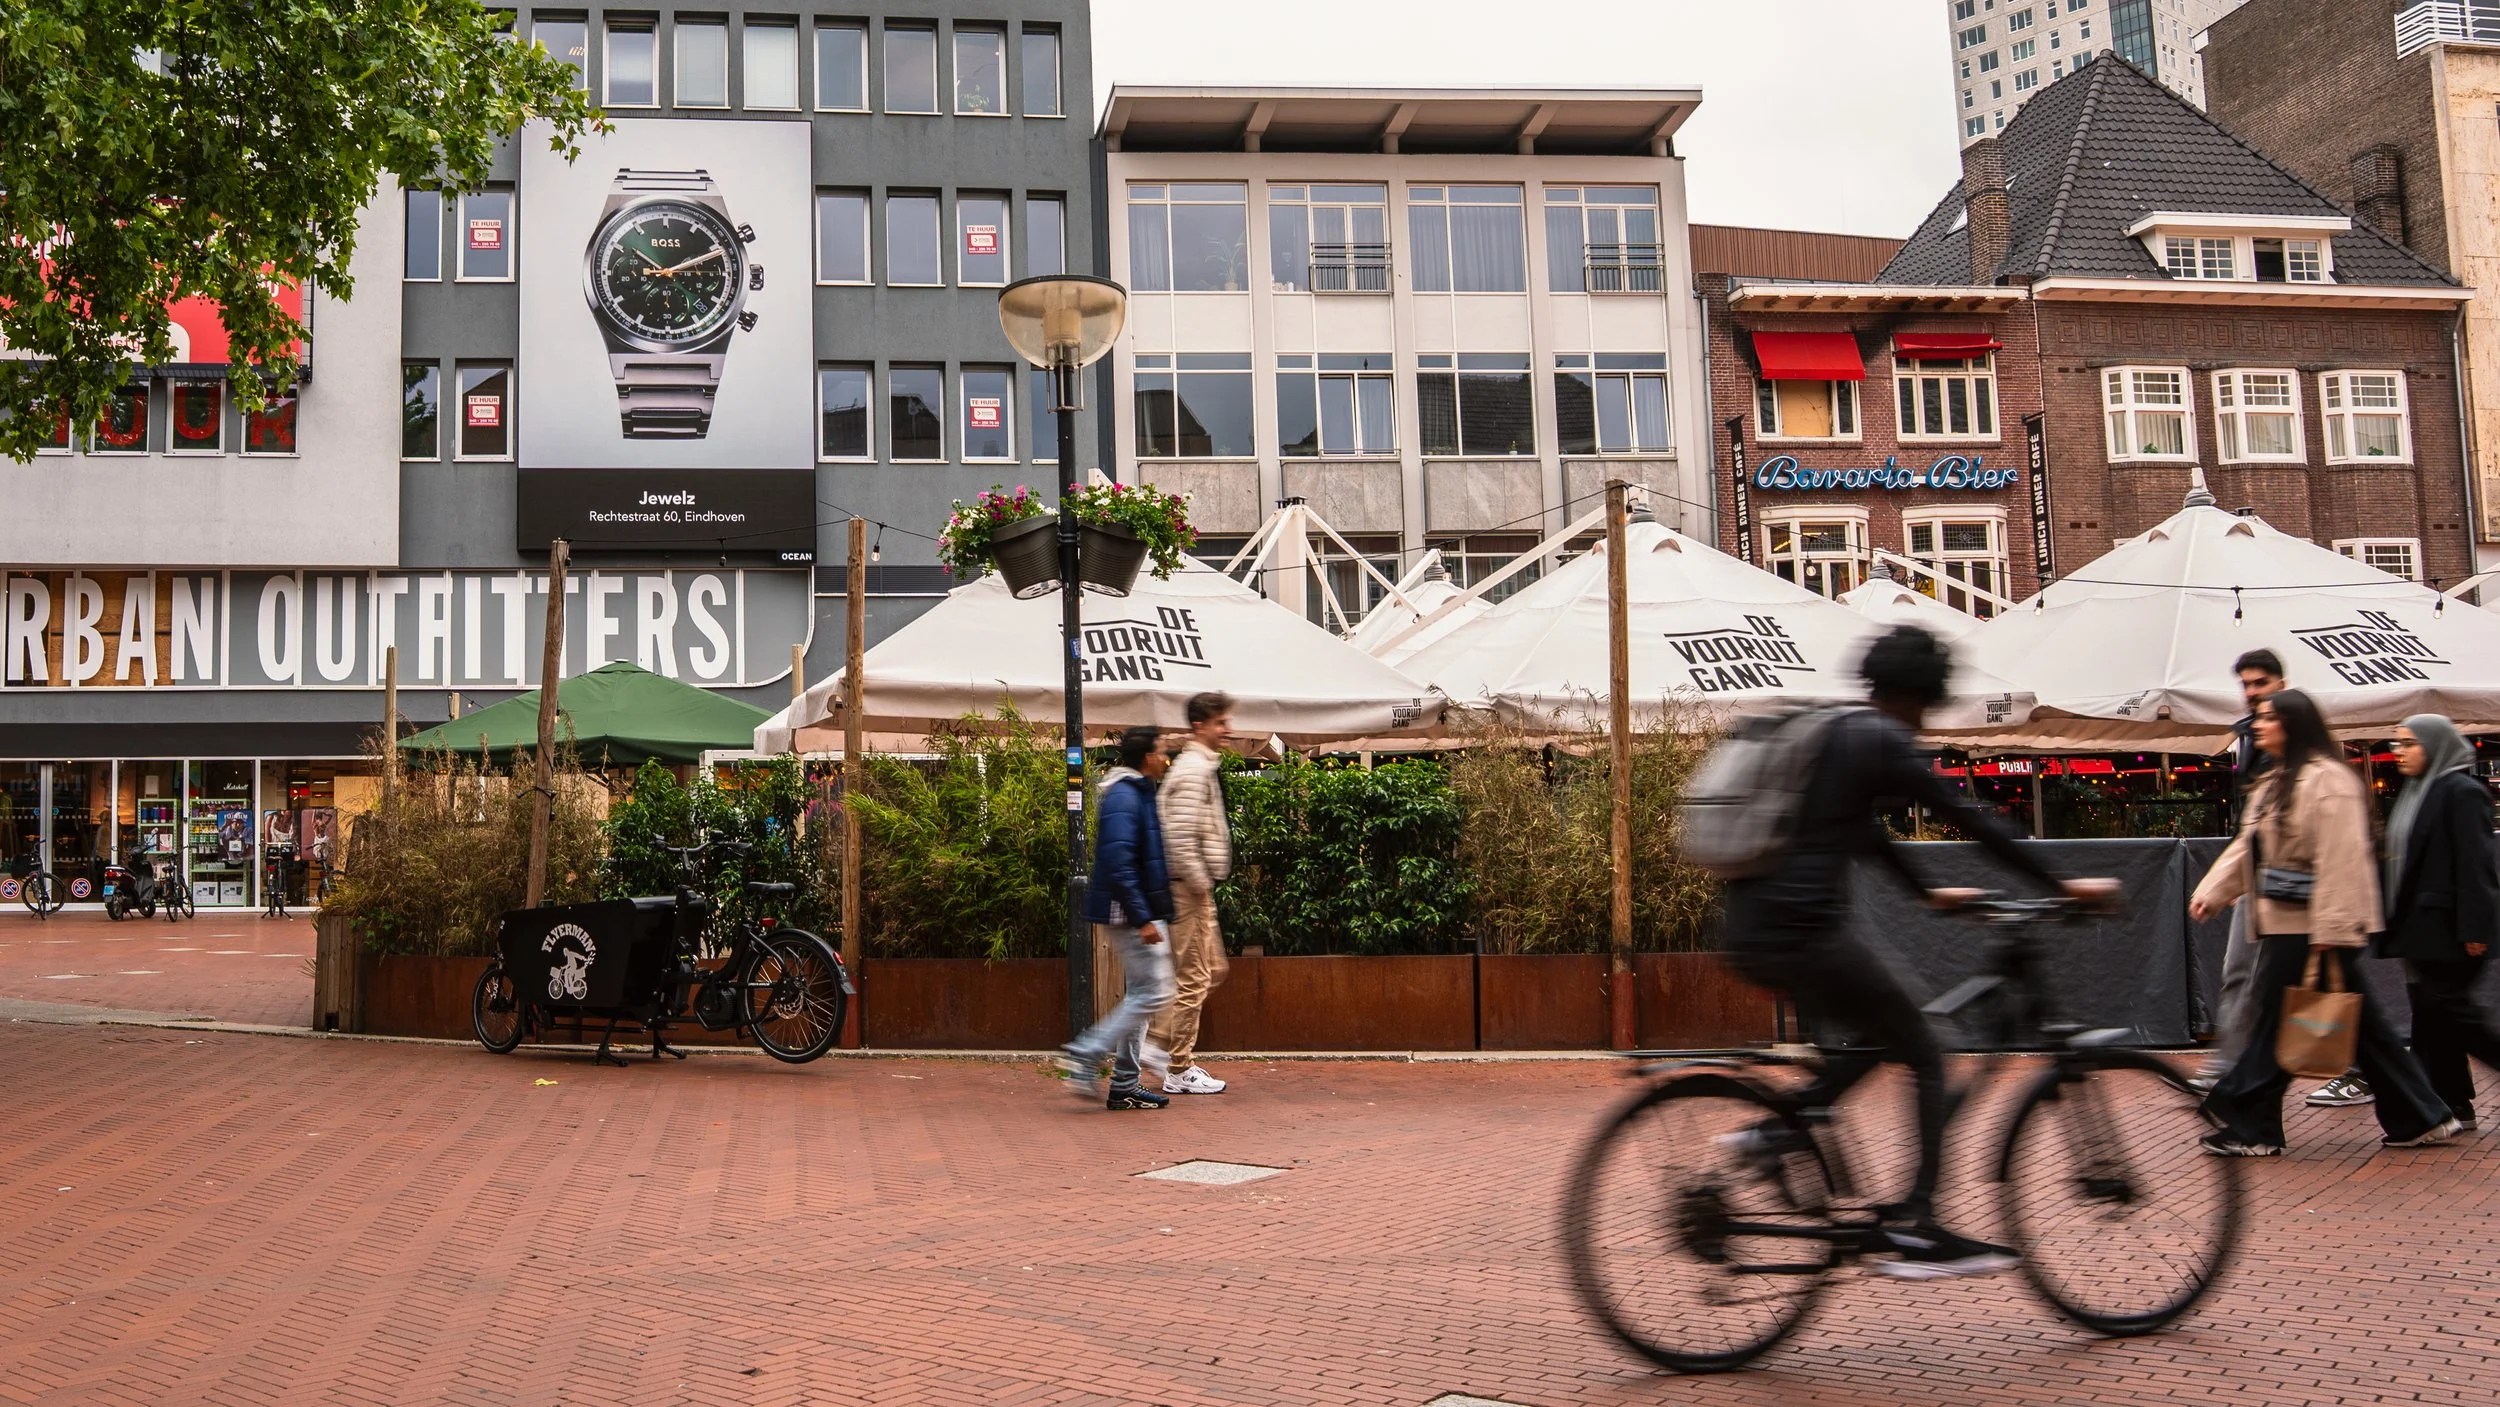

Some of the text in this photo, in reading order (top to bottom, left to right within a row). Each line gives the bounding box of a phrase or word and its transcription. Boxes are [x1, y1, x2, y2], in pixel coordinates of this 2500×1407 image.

[651, 238, 681, 248] BOSS
[695, 301, 708, 313] 28
[1754, 454, 2018, 490] Bavaria Bier
[639, 490, 696, 505] Jewelz
[1733, 441, 1750, 565] NCH DINER CAFÉ
[2029, 433, 2049, 567] LUNCH DINER CAFÉ
[589, 510, 745, 523] Rechtestraat 60, Eindhoven
[781, 553, 812, 561] OCEAN
[257, 574, 730, 681] OUTFITTERS
[1156, 606, 1199, 632] DE
[1743, 614, 1790, 638] DE
[2356, 609, 2410, 632] DE
[1061, 627, 1204, 660] OORUIT
[1669, 636, 1806, 664] VOORUIT
[2298, 630, 2438, 659] VOORUIT
[1688, 663, 1784, 692] GANG
[2329, 656, 2430, 686] GANG
[1392, 708, 1422, 718] VOORUIT
[1986, 703, 2012, 713] VOORUIT
[1986, 714, 2003, 723] GANG
[1392, 719, 1410, 728] GANG
[1999, 761, 2032, 773] PUBLI
[541, 923, 597, 953] FLYERMAN
